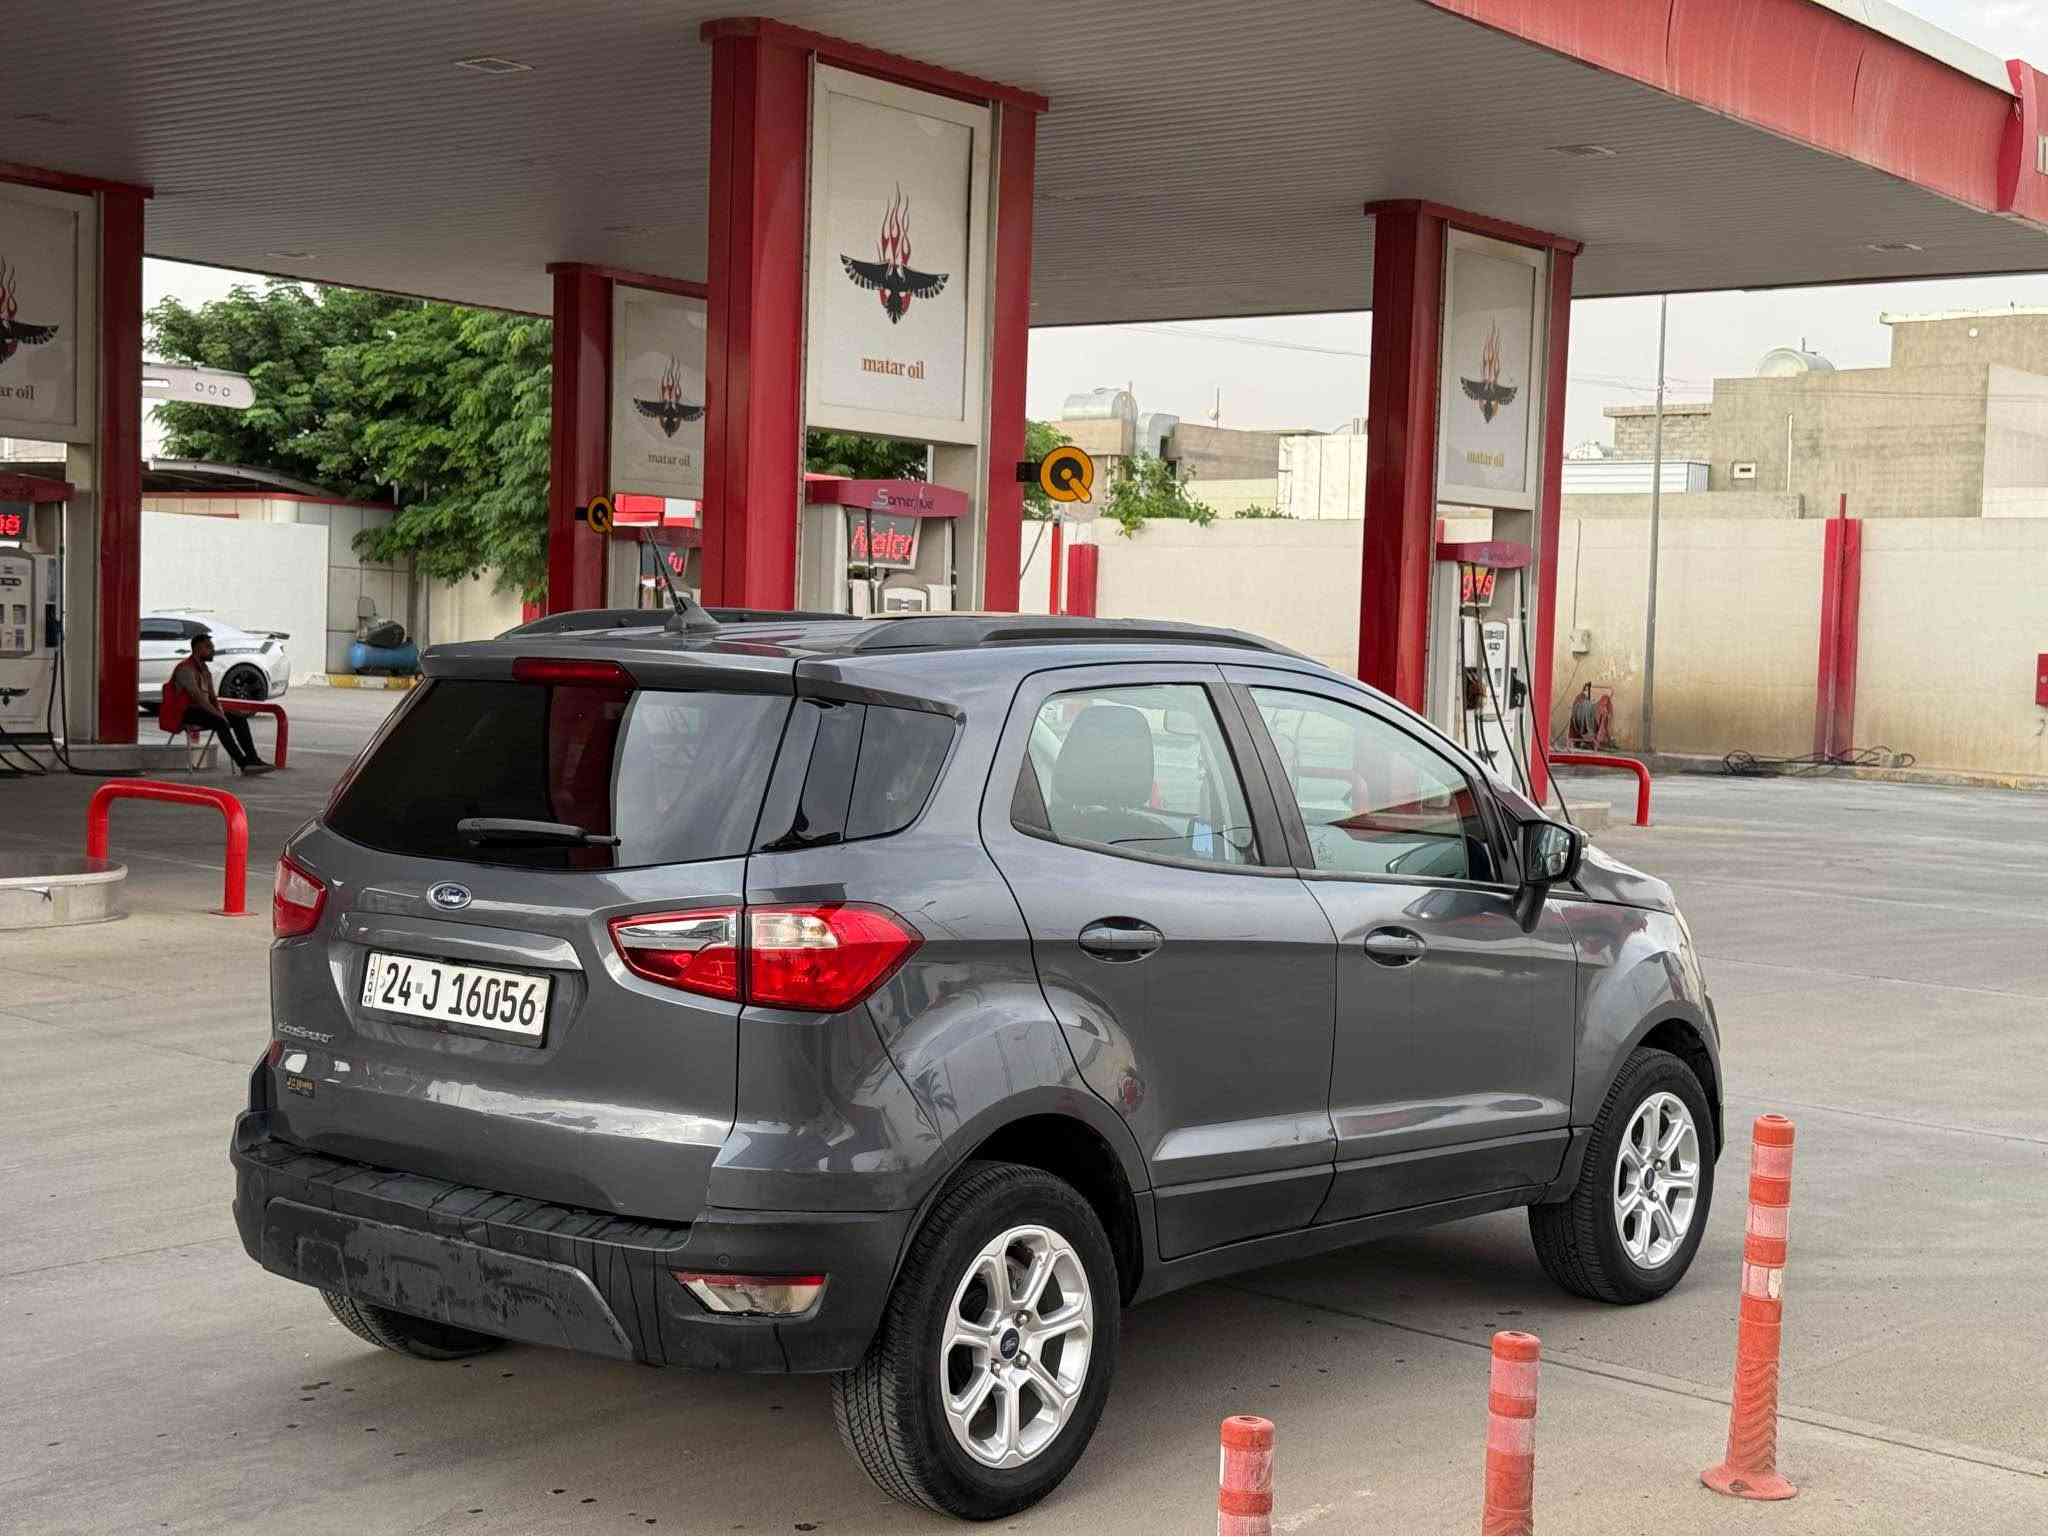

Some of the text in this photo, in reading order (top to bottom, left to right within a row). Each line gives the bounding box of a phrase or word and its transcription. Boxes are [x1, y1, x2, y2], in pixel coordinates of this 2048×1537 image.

[862, 357, 924, 380] matar oil
[16, 385, 34, 400] oil
[648, 453, 691, 467] matar oil
[382, 962, 537, 1026] 24 J 16056
